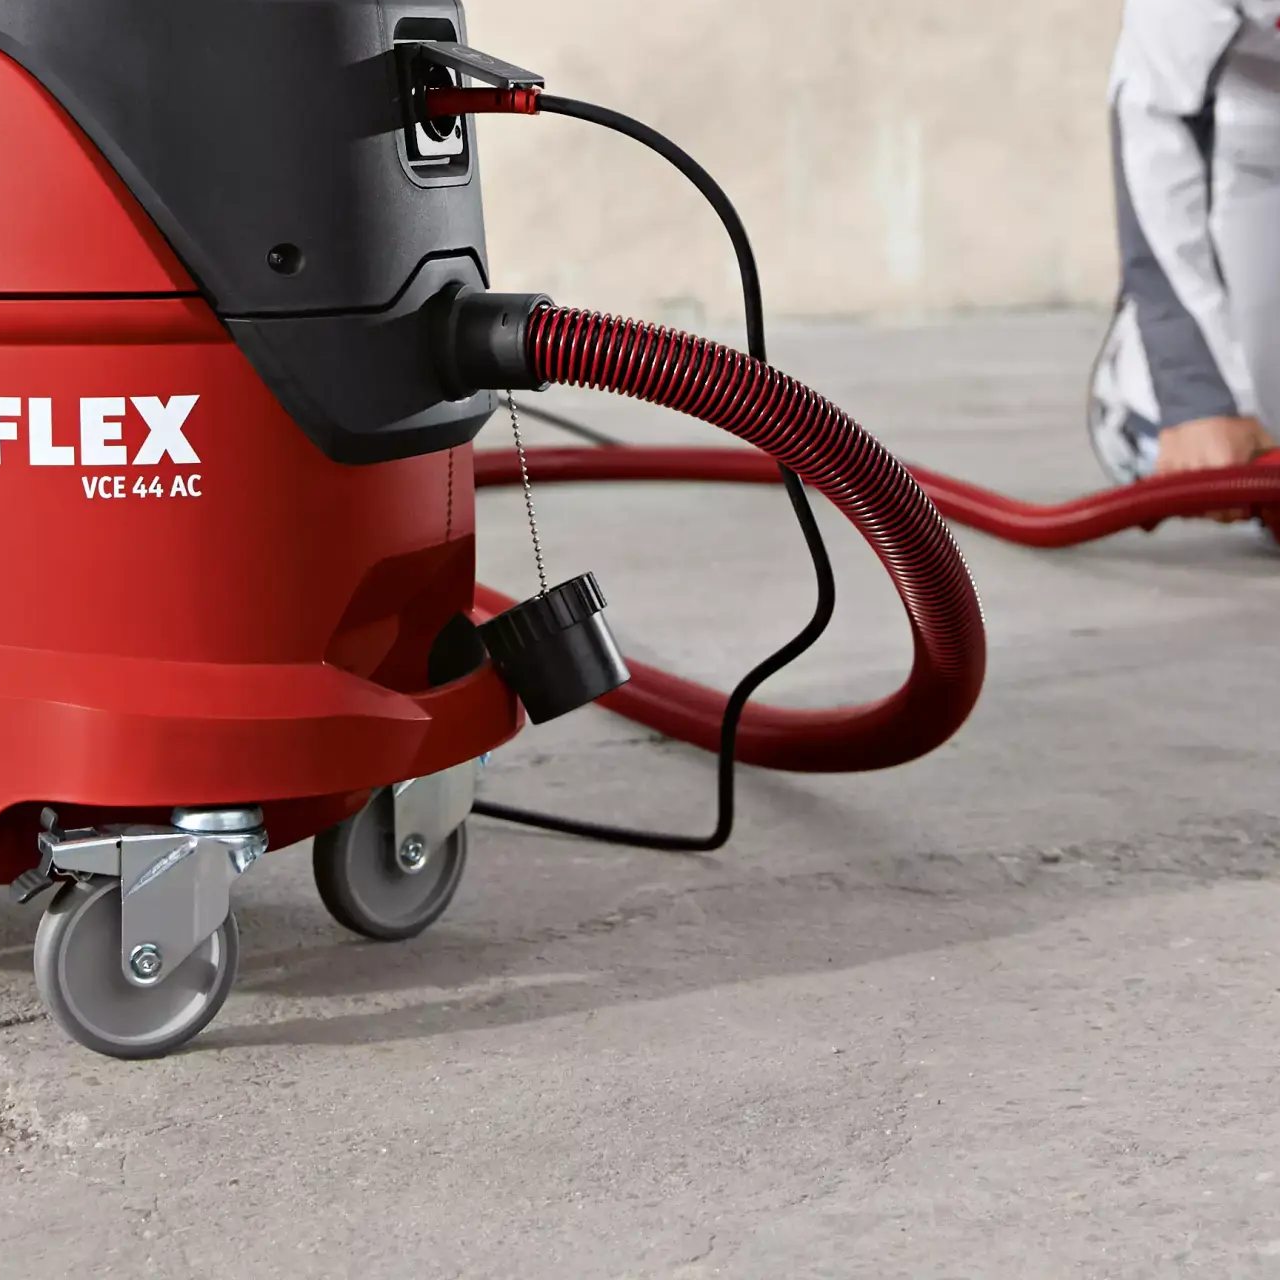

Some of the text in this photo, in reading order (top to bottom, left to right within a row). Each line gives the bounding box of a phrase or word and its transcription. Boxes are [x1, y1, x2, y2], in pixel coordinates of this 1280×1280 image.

[82, 474, 202, 498] VCE 44 AC
